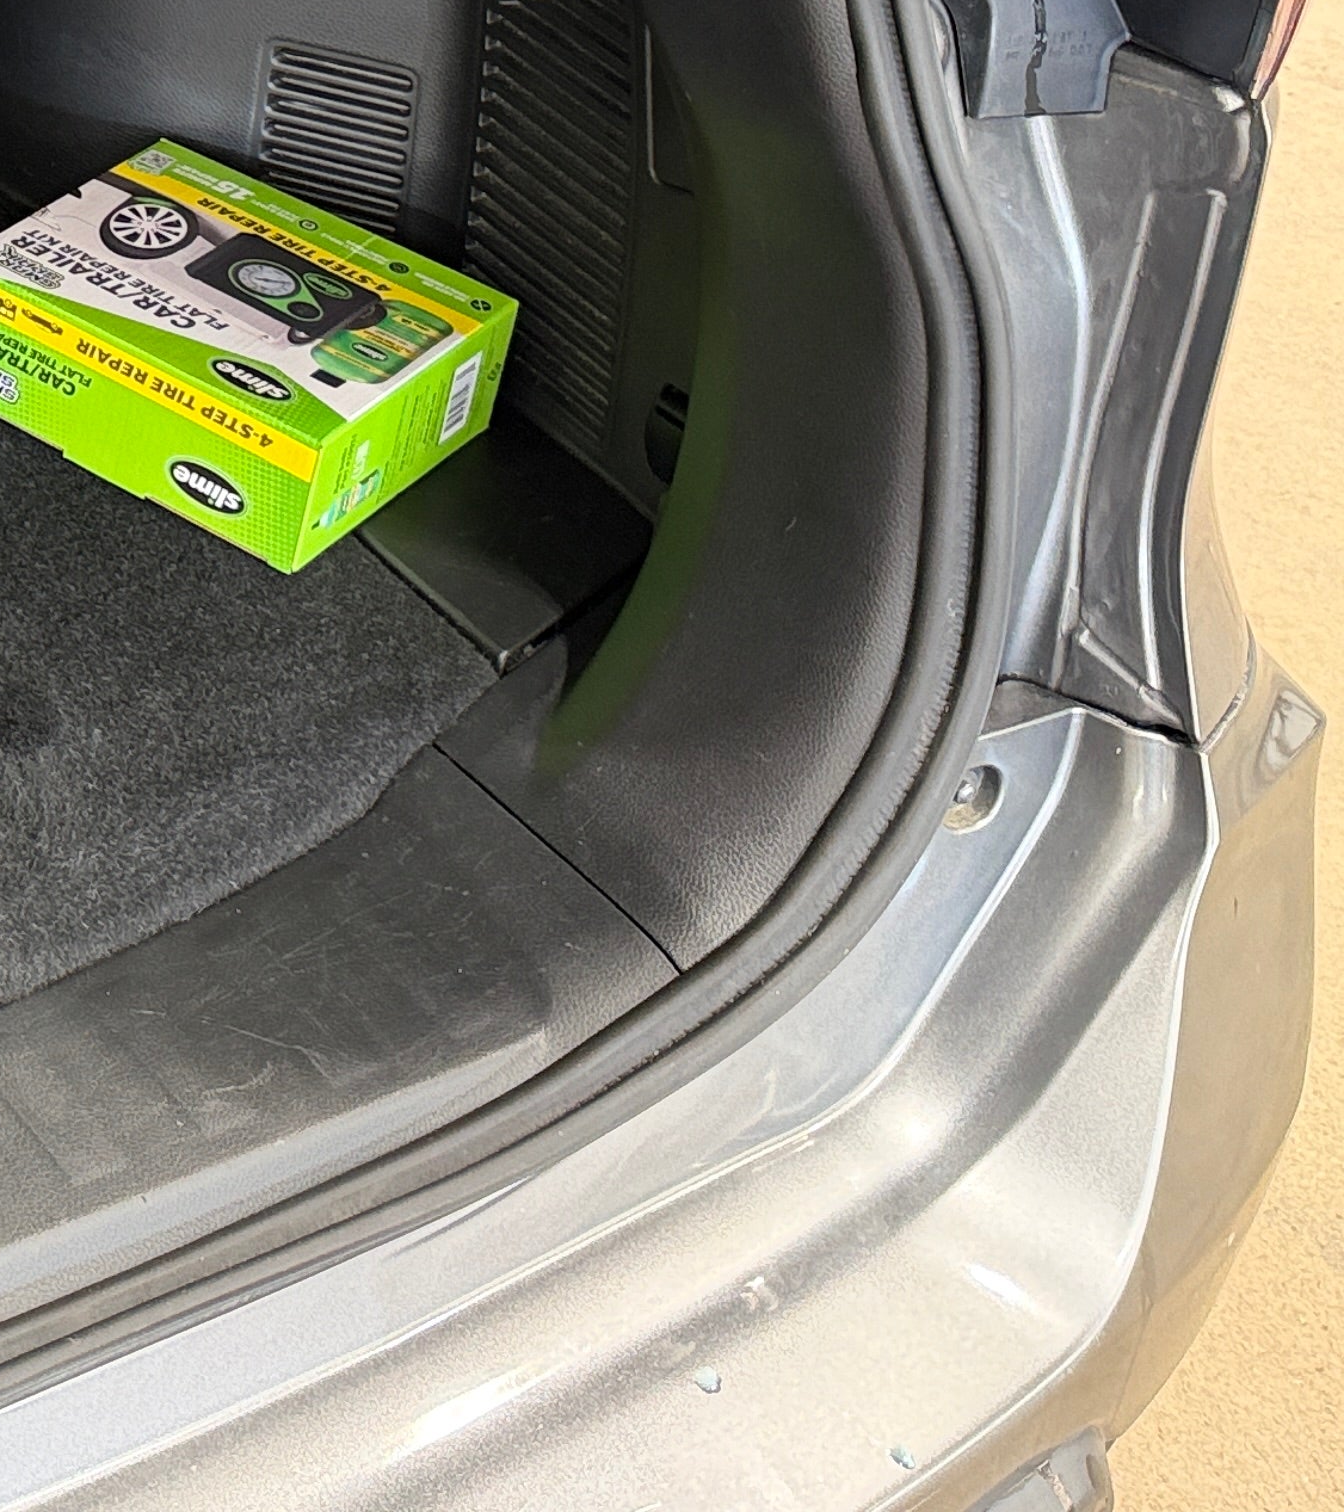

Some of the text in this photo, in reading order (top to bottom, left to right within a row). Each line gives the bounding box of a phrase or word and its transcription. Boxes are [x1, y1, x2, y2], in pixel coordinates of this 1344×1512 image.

[211, 180, 256, 201] 15
[196, 197, 269, 235] REPAIR
[270, 232, 318, 262] TIRE
[10, 234, 197, 329] CAR/TRAILER
[23, 229, 230, 331] FLAT TIRE REPAIR KIT
[318, 257, 392, 292] 4-STEP
[27, 350, 57, 371] TIRE
[58, 365, 92, 388] FLAT
[215, 360, 290, 399] slime
[75, 337, 274, 449] 4-STEP TIRE REPAIR
[172, 464, 242, 511] slime
